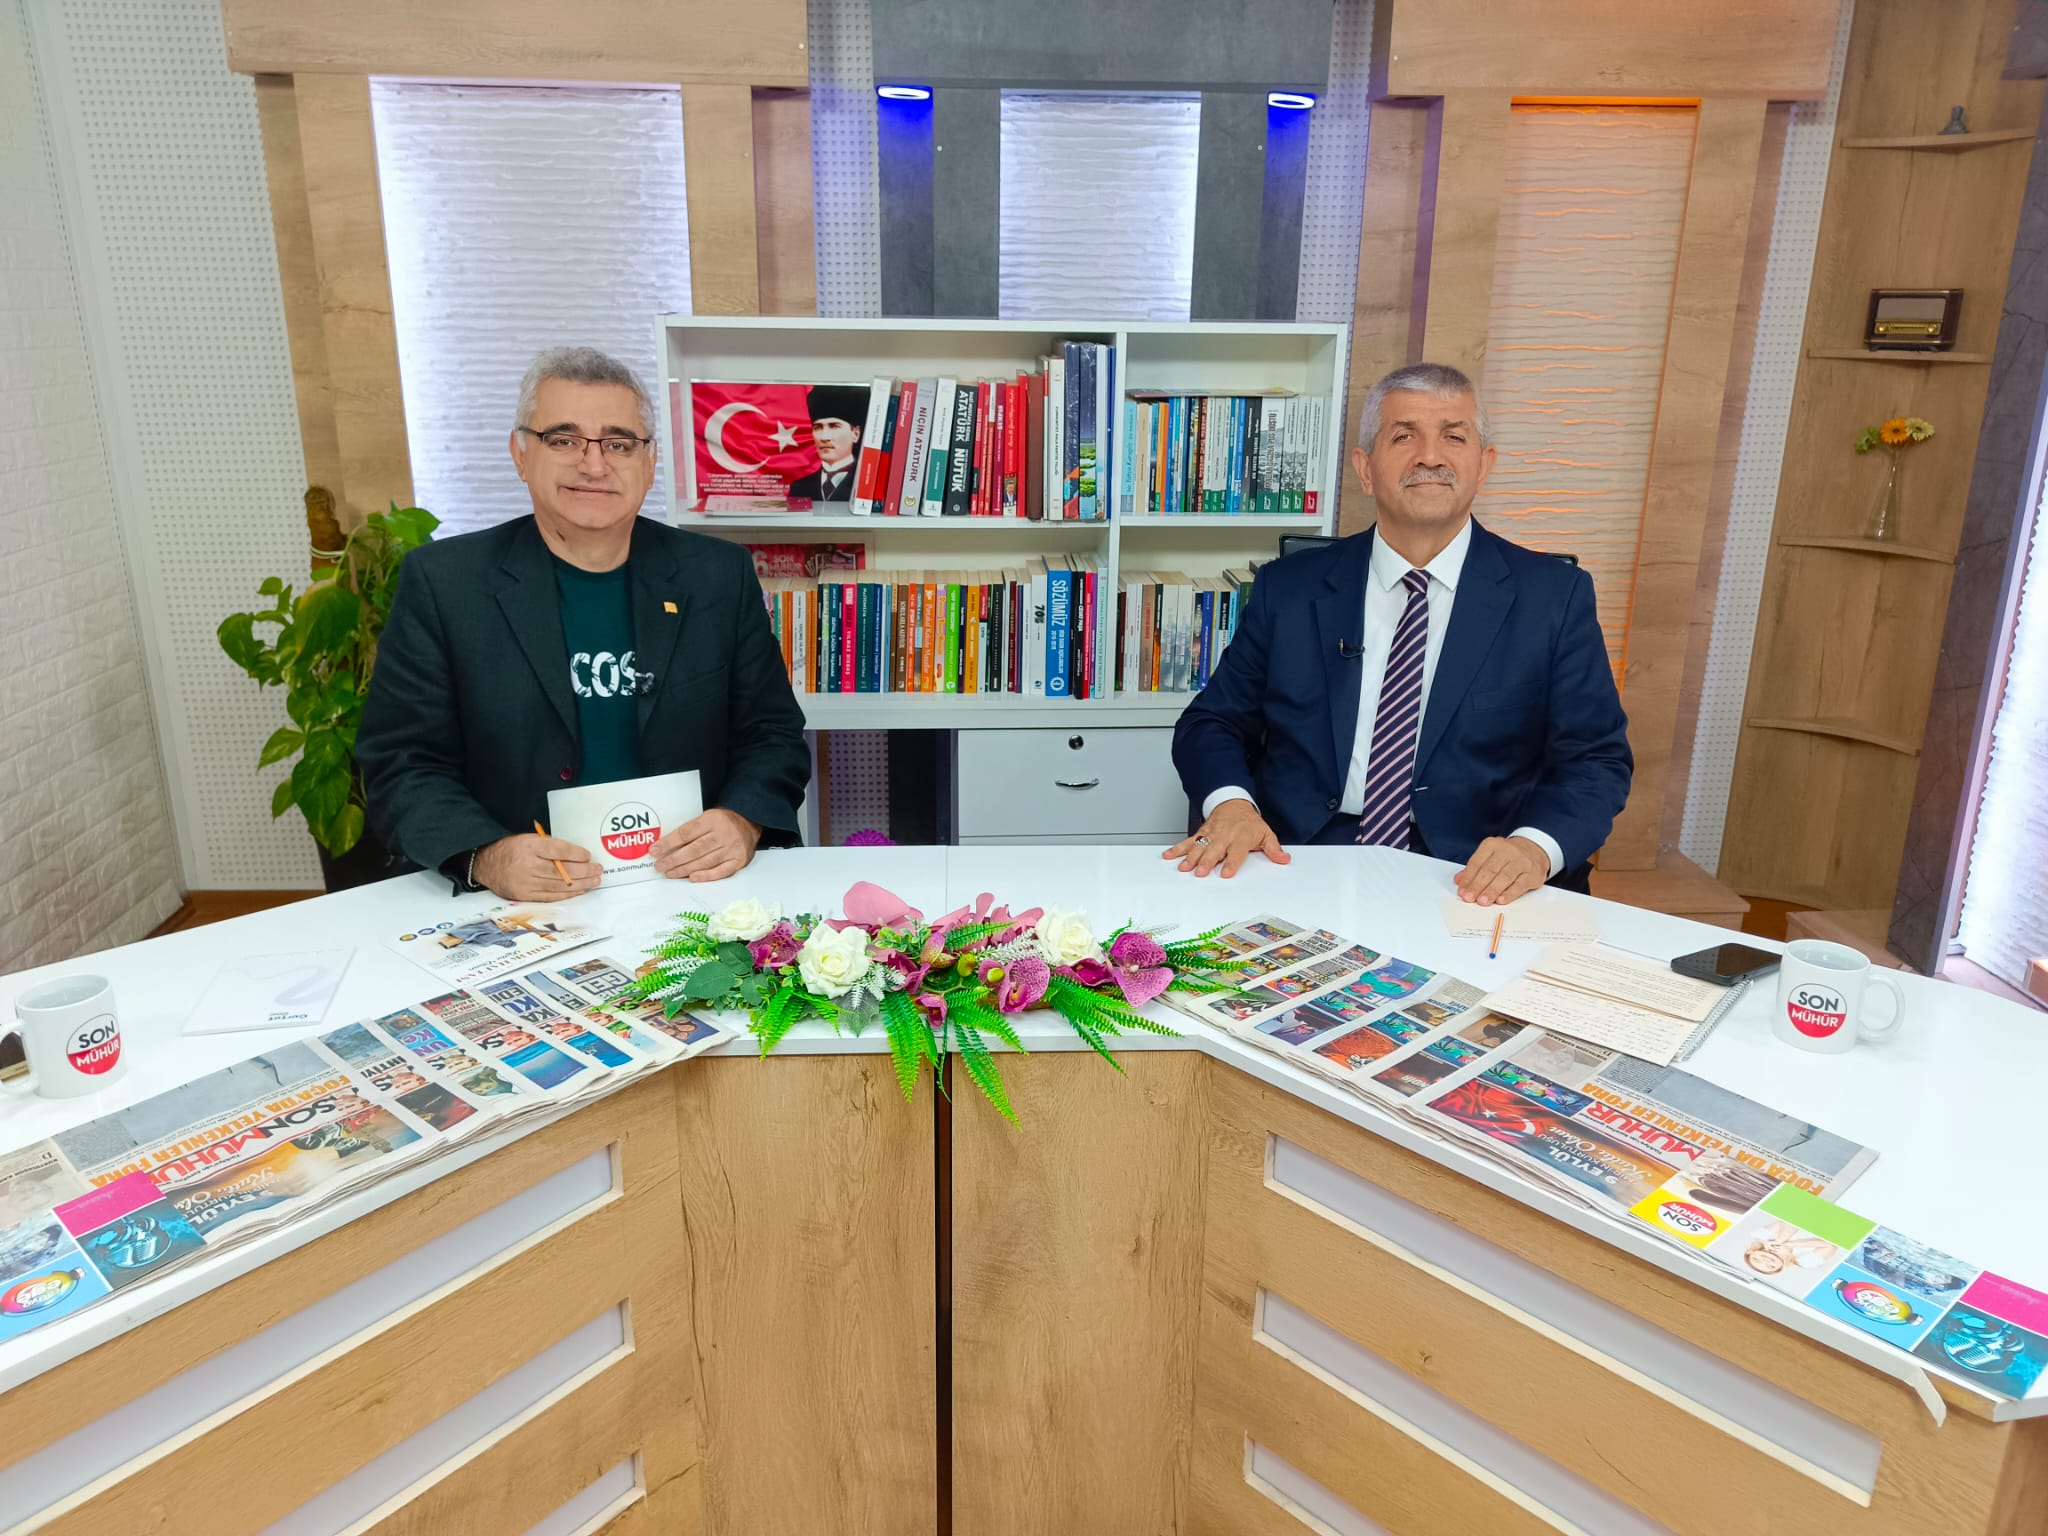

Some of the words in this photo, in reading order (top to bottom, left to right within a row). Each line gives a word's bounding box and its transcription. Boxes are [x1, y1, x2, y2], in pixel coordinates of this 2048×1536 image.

[916, 407, 928, 435] NİÇİN
[955, 390, 968, 442] ATATÜRK
[909, 437, 922, 482] ATATÜRK
[952, 448, 966, 492] NUTUK
[1051, 580, 1067, 627] SÖZÜMÜZ
[611, 812, 650, 832] SON
[607, 830, 654, 850] MÜHÜR
[1797, 991, 1839, 1012] SON
[1791, 1007, 1838, 1027] MÜHÜR
[78, 1020, 115, 1049] SON
[76, 1039, 120, 1067] MÜHÜR
[264, 1074, 352, 1113] FOÇA'DA
[1580, 1083, 1626, 1109] FORA
[151, 1111, 265, 1163] YELKENLER
[1549, 1125, 1593, 1152] Olsun
[1630, 1105, 1735, 1155] YELKENLER
[1550, 1147, 1604, 1177] EYLÜL
[1599, 1148, 1653, 1181] Kutlu
[1735, 1149, 1825, 1197] FOÇA'DA
[1604, 1175, 1617, 1185] 9
[189, 1194, 256, 1226] EYLÜL
[1663, 1211, 1702, 1232] SON
[1670, 1203, 1714, 1227] MÜHÜR
